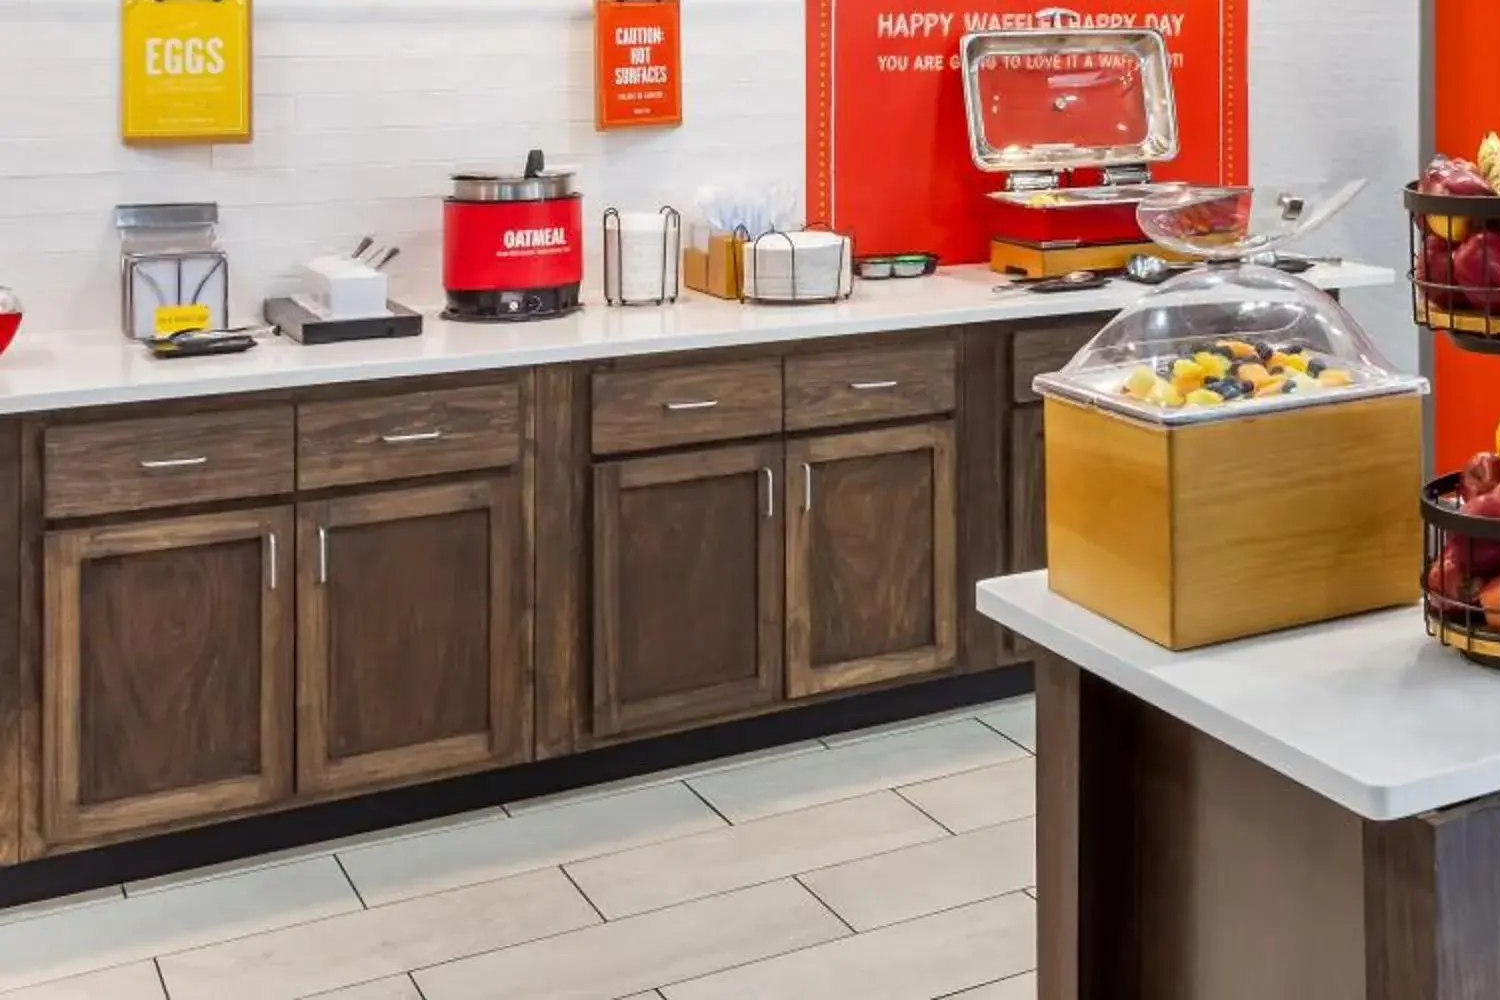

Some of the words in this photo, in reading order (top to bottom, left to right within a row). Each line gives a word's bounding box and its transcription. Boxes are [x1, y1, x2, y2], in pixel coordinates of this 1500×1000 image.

[877, 12, 955, 38] HAPPY
[145, 37, 226, 76] EGGS
[878, 55, 907, 71] YOU
[913, 55, 944, 71] ARE
[1004, 55, 1022, 71] TO
[1027, 55, 1061, 70] LOVE
[1067, 55, 1081, 69] IT
[503, 227, 568, 250] OATMEAL
